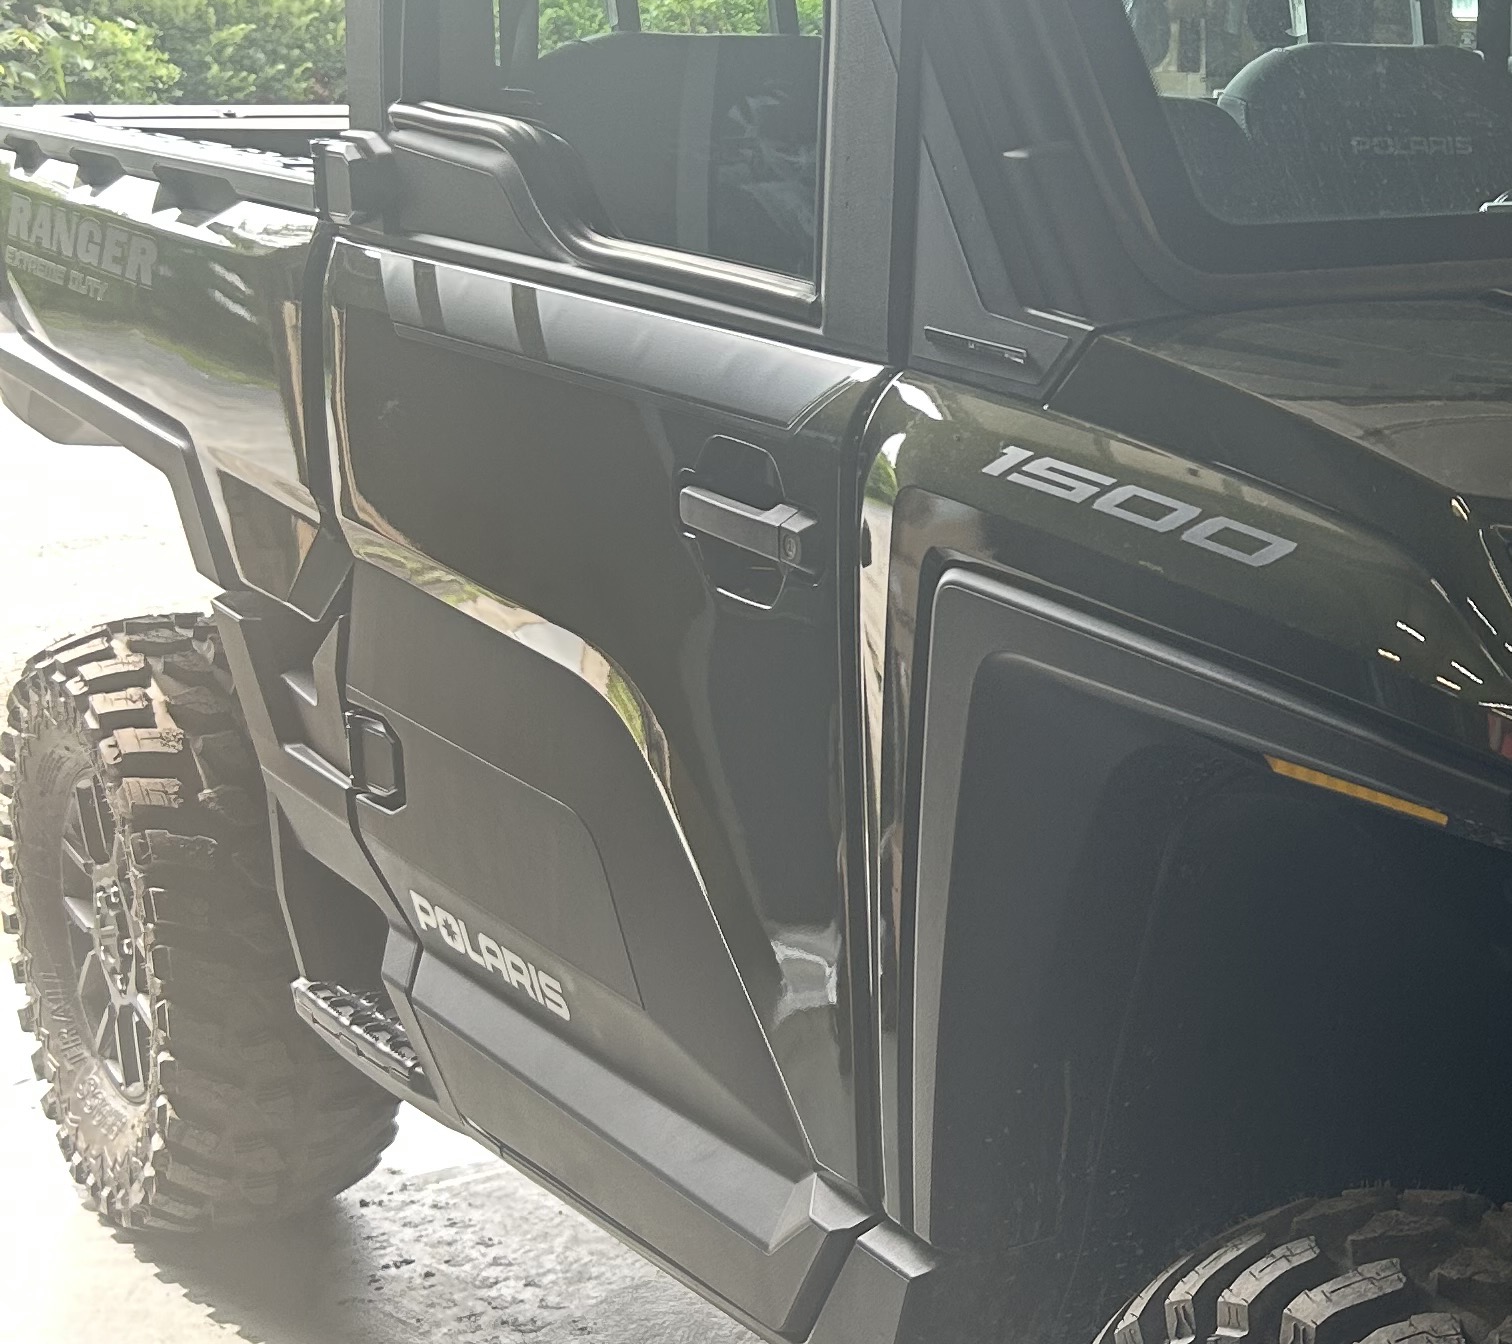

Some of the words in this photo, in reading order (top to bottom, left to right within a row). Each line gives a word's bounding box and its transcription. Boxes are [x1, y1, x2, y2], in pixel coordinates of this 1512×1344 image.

[1350, 136, 1473, 156] POLARIS
[5, 244, 67, 286] EXTREME
[68, 269, 109, 301] DUTY
[7, 192, 157, 289] RANGER
[982, 445, 1298, 567] 1500
[409, 889, 571, 1021] POLARIS
